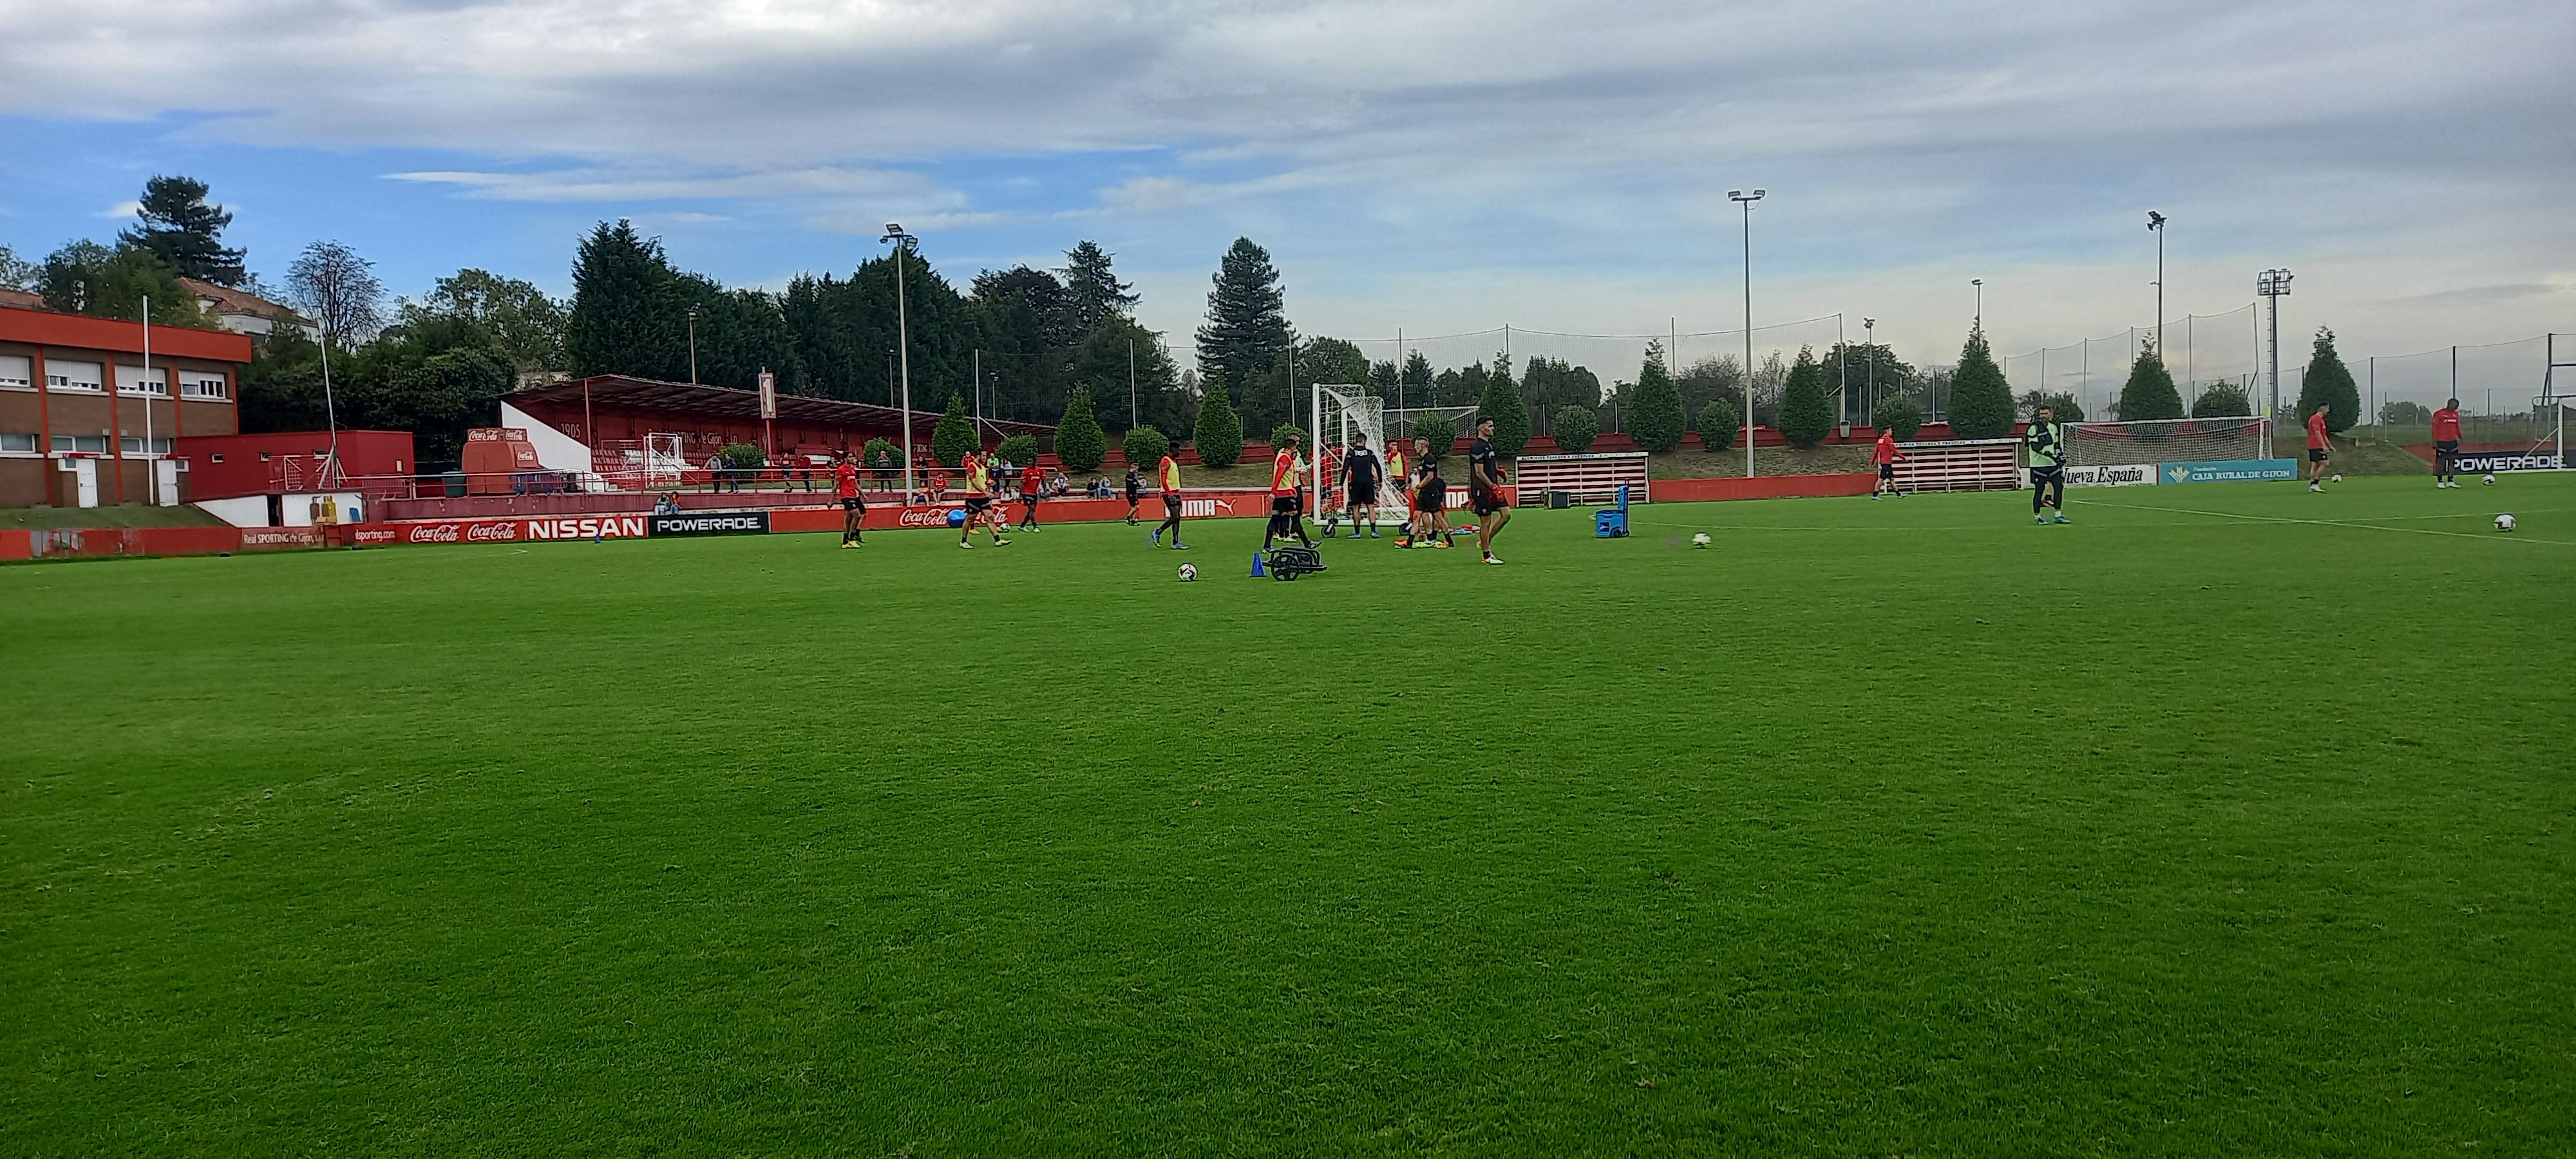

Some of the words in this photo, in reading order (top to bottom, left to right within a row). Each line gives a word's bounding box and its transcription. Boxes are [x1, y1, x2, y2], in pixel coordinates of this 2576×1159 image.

[561, 423, 580, 438] 1905
[2097, 466, 2143, 485] España
[2215, 471, 2248, 479] RURAL
[900, 507, 951, 526] Coca-Cola
[1165, 499, 1216, 518] UMA
[244, 534, 256, 543] Real
[258, 533, 289, 543] SPORTING
[290, 533, 298, 543] de
[410, 524, 460, 542] Coca-Cola
[467, 522, 517, 541] Coca-Cola
[529, 517, 643, 540] NISSAN
